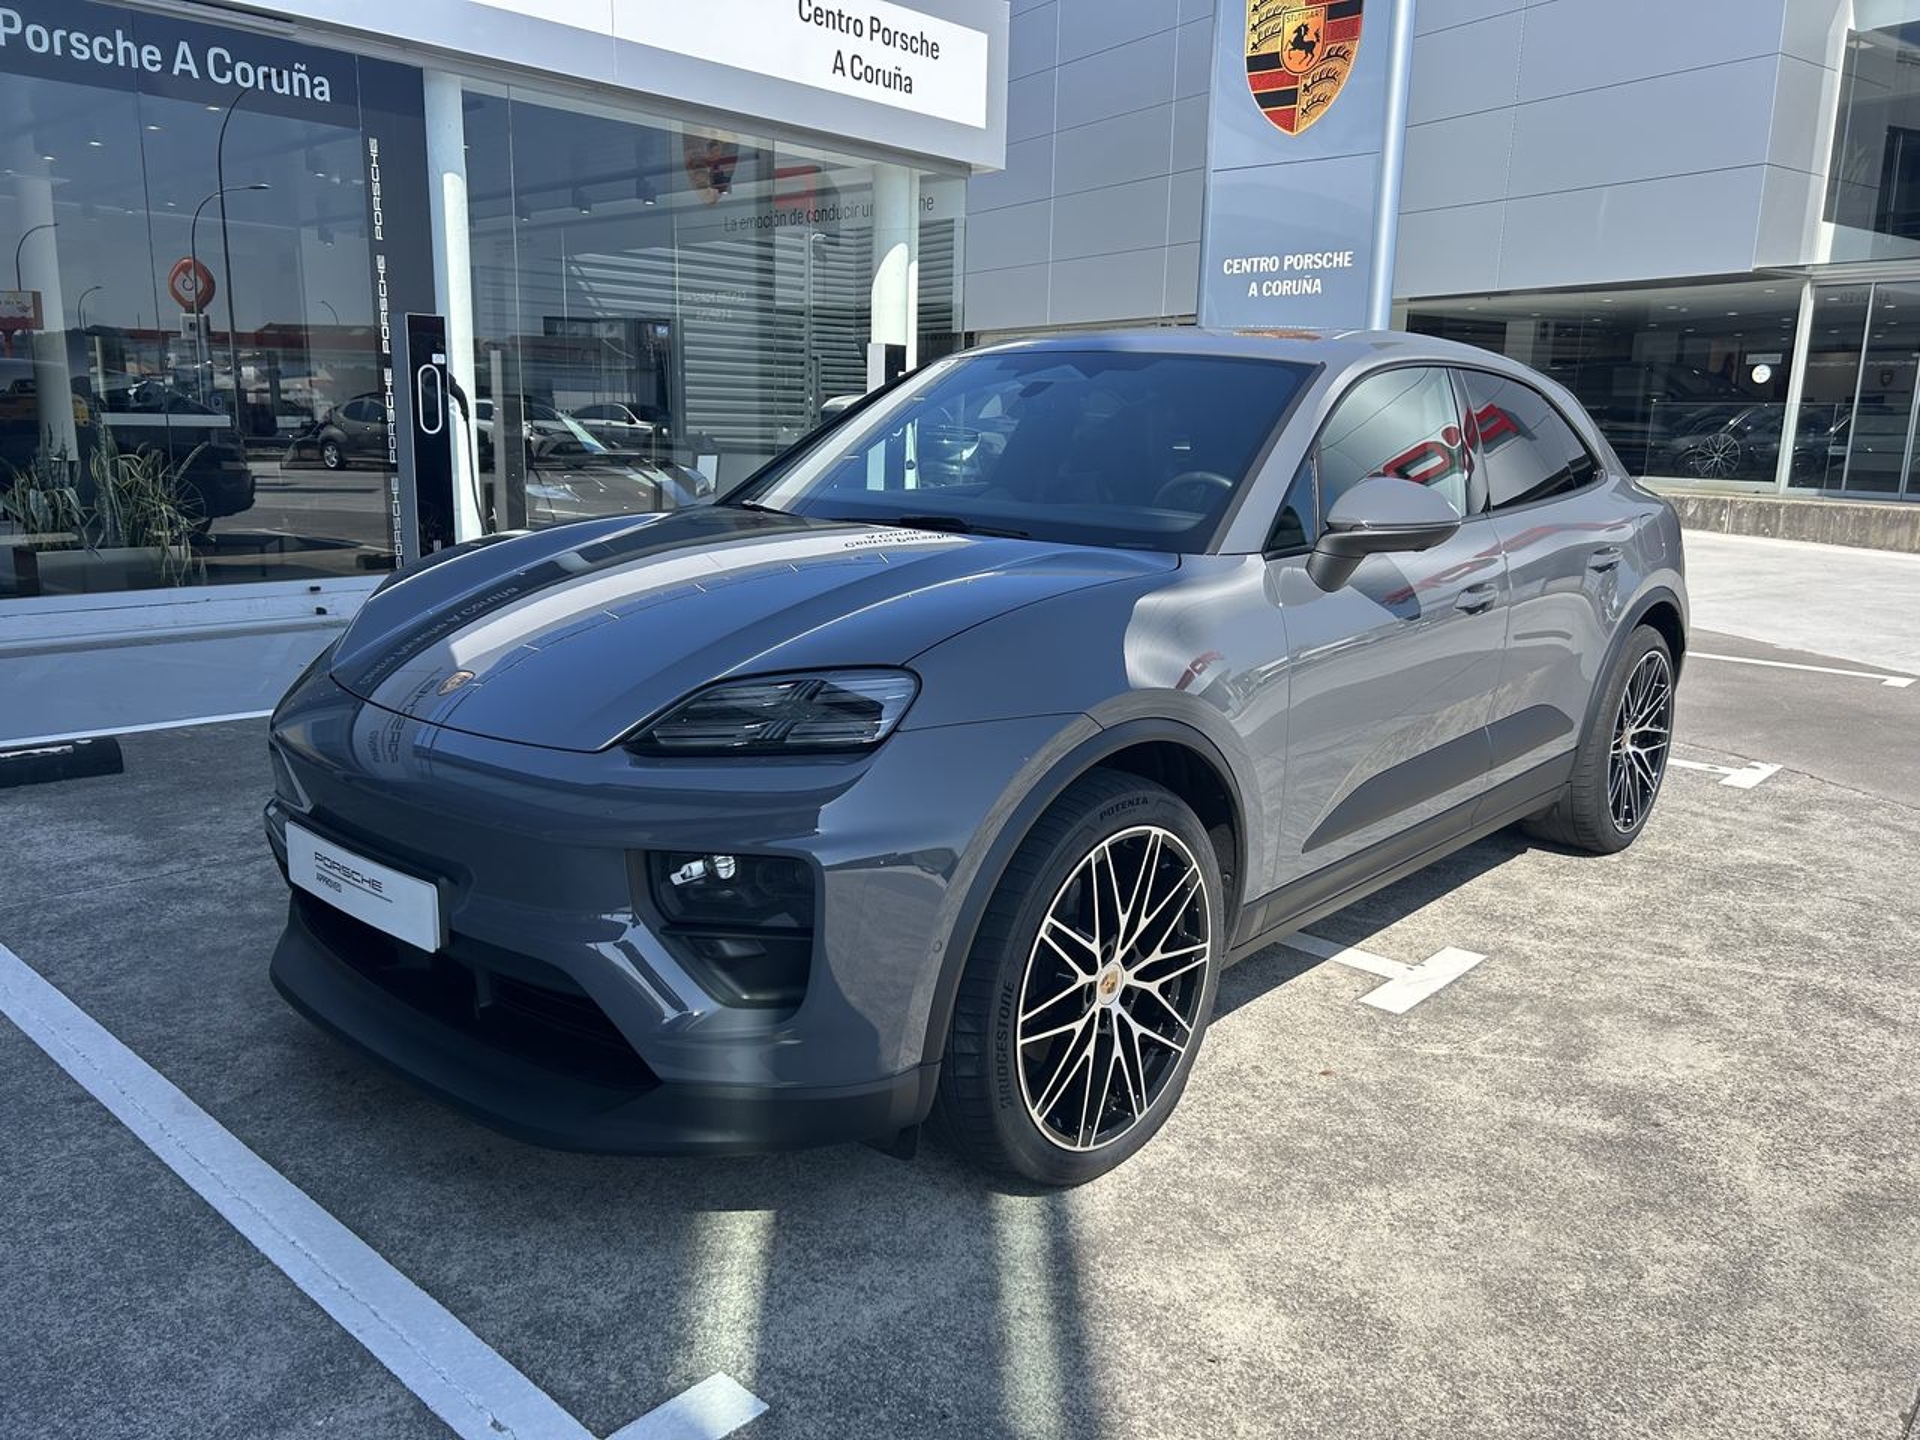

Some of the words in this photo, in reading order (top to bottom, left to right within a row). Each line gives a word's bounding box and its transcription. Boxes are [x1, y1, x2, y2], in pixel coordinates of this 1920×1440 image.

[0, 8, 162, 72] Porsche
[172, 41, 199, 79] A
[206, 47, 331, 102] Coruña
[798, 0, 864, 38] Centro
[869, 16, 940, 60] Porsche
[832, 49, 846, 77] A
[850, 54, 913, 95] Coruña
[369, 137, 383, 240] PORSCHE
[790, 208, 804, 226] de
[806, 203, 859, 224] conducir
[1223, 257, 1279, 275] CENTRO
[1284, 251, 1354, 270] PORSCHE
[1248, 281, 1258, 297] A
[1262, 274, 1322, 296] CORUÑA
[376, 254, 390, 354] PORSCHE
[383, 367, 397, 464] PORSCHE
[315, 851, 383, 893] PORSCHE
